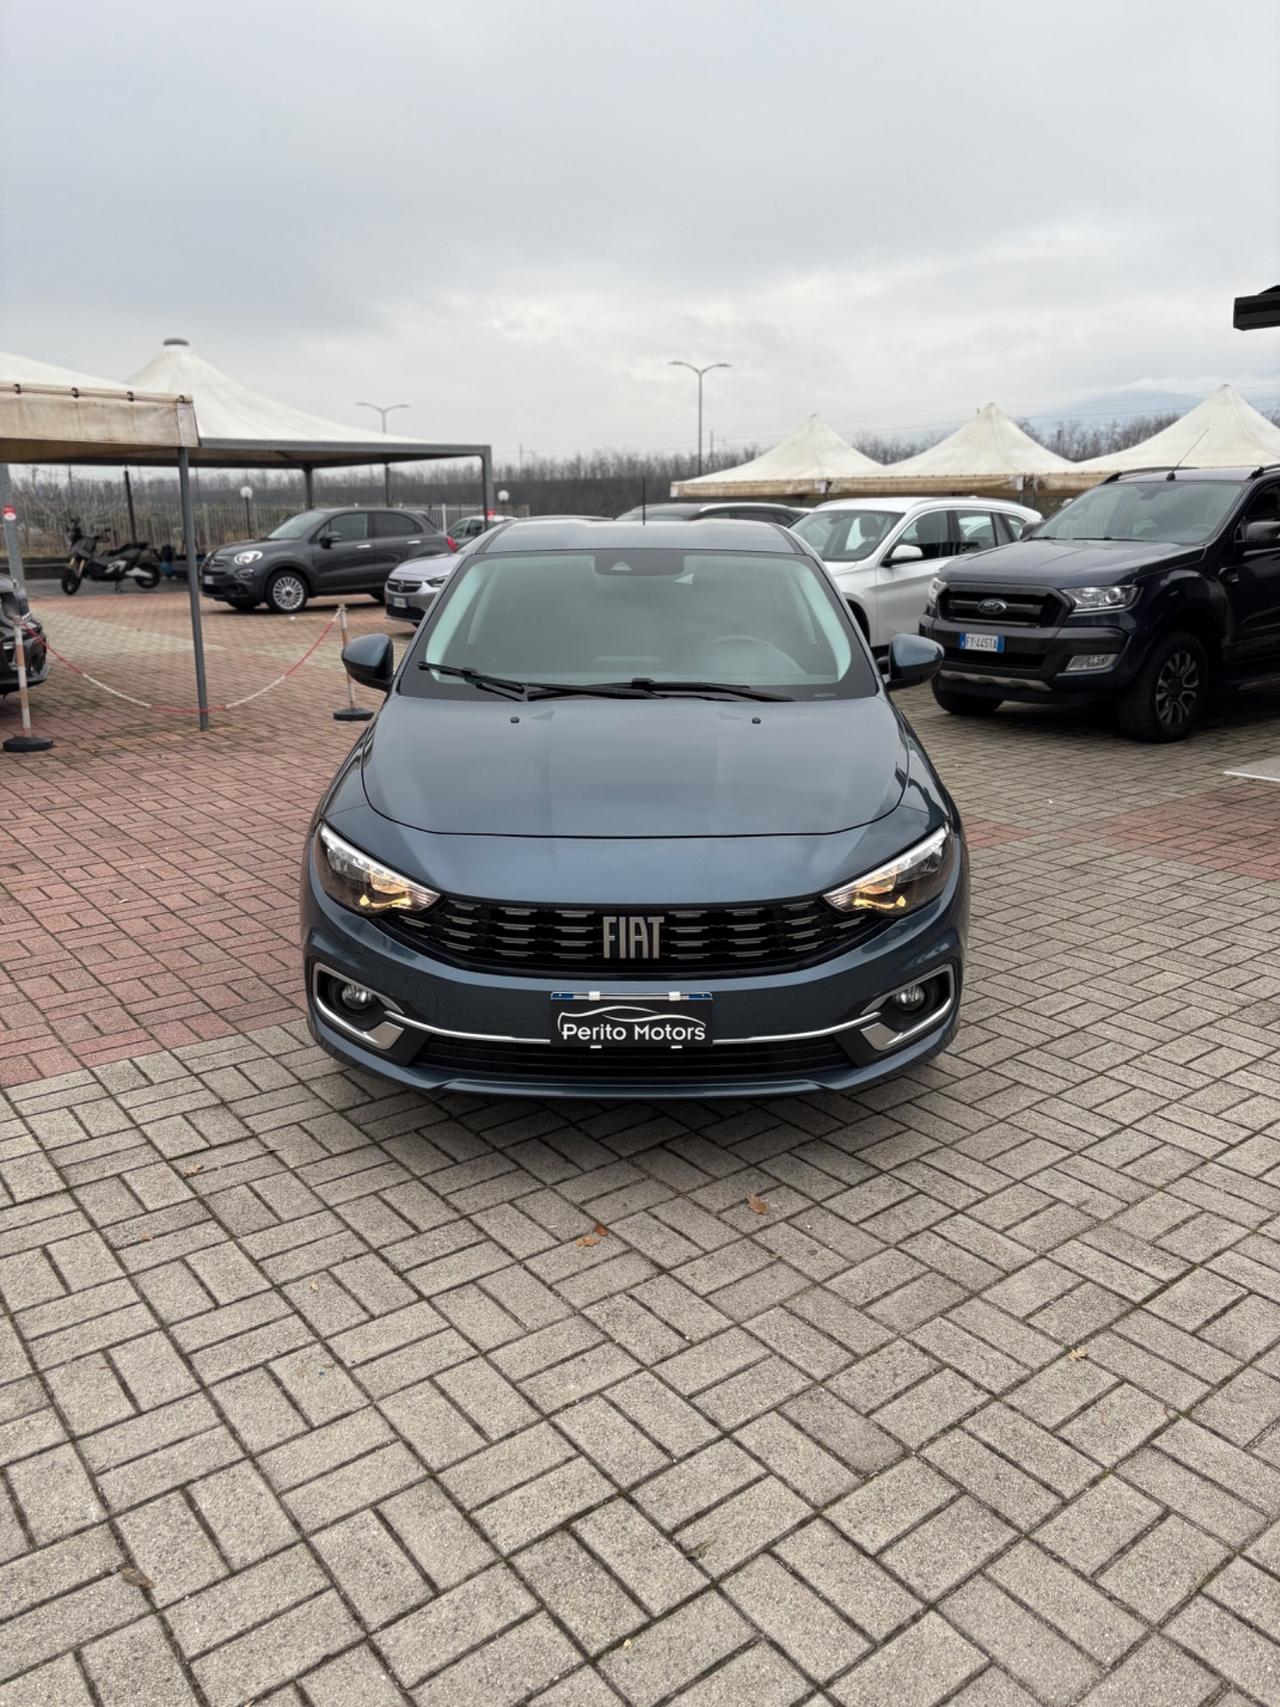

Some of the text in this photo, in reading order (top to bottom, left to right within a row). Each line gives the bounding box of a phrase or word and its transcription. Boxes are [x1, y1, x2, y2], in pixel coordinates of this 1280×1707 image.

[603, 916, 665, 959] FIAT
[561, 1023, 706, 1041] Perito Motors
